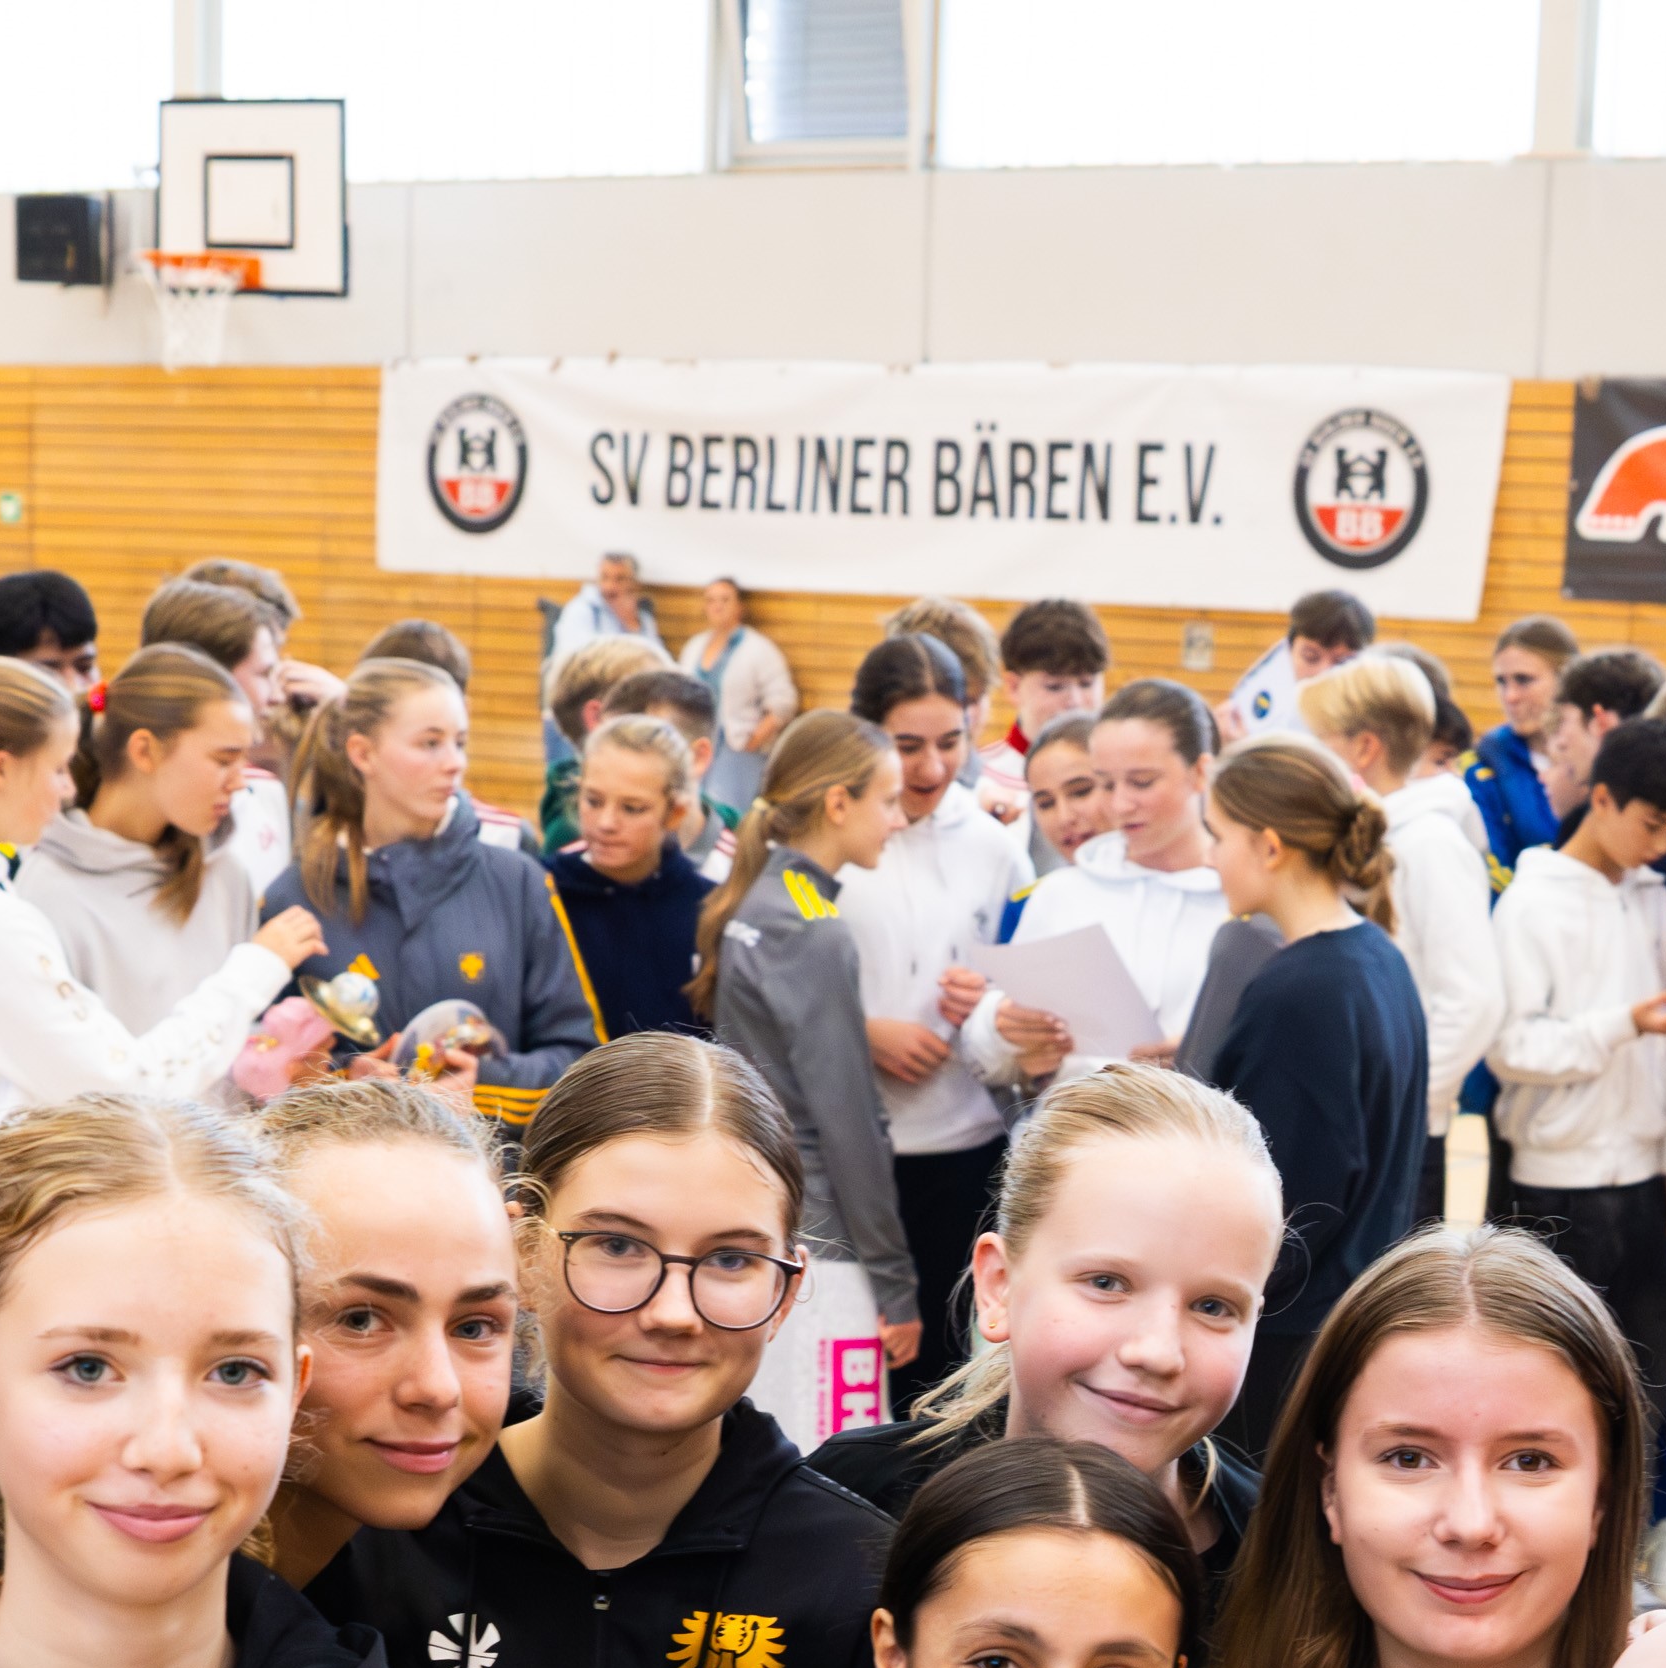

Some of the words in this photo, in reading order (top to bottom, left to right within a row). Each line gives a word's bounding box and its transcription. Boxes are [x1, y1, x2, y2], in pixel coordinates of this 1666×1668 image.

[590, 430, 648, 508] SV
[665, 432, 911, 517] BERLINER
[933, 422, 1112, 523] BÄREN
[1135, 441, 1222, 526] E.V.
